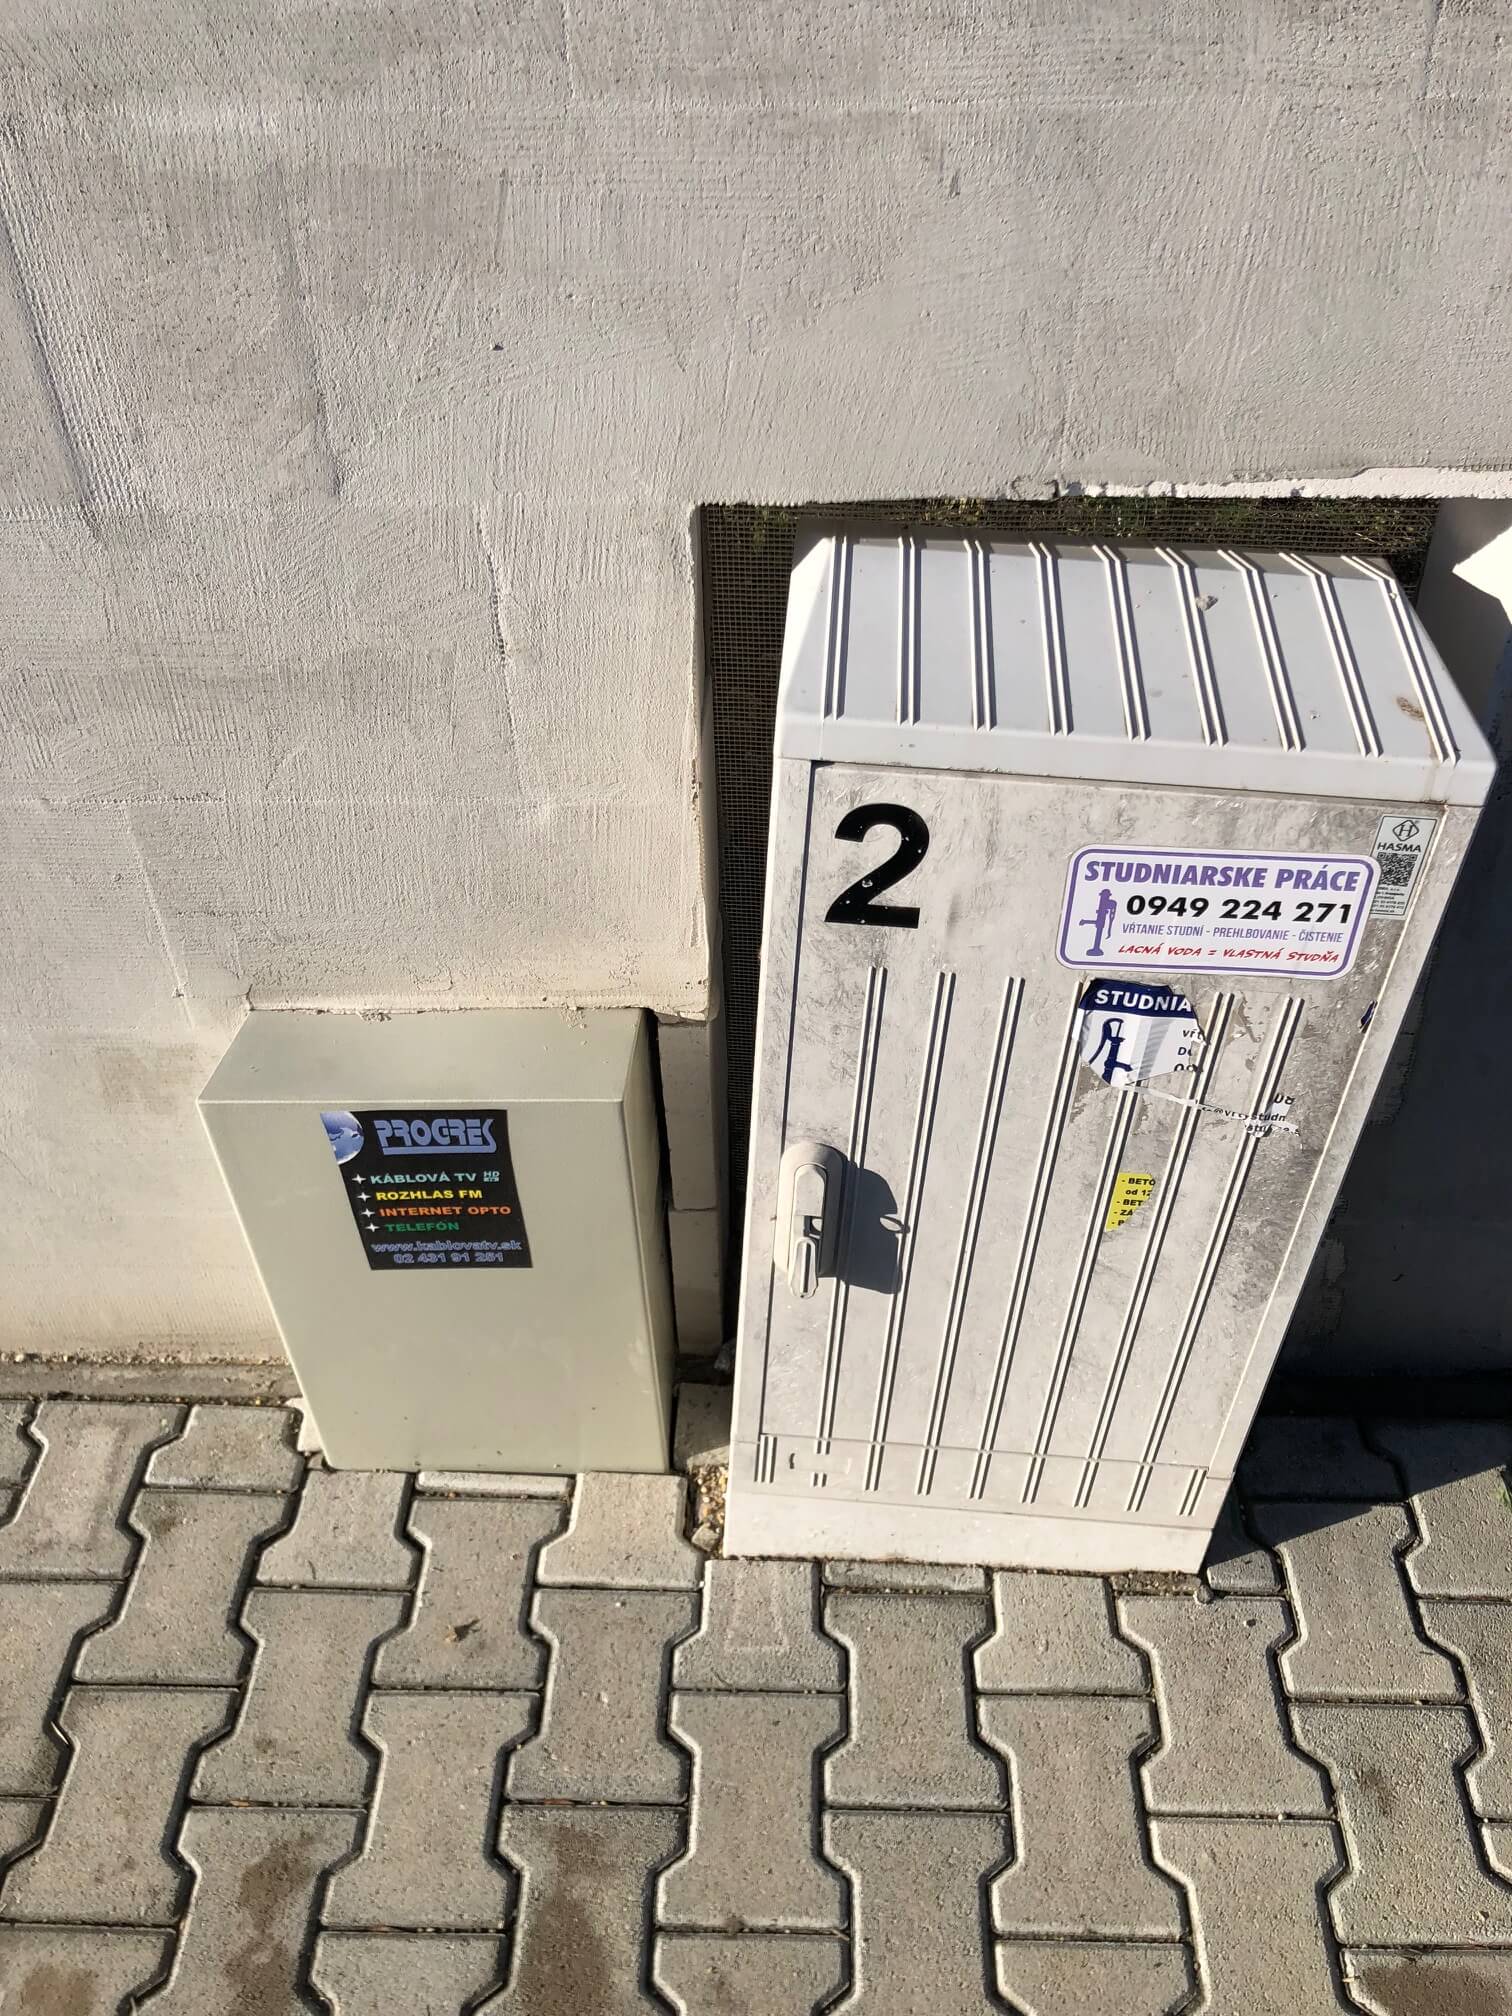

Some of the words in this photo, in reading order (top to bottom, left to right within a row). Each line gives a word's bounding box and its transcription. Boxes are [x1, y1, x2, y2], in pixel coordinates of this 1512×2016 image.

[1377, 843, 1421, 852] HASMA
[824, 803, 930, 929] 2
[1084, 860, 1268, 888] STUDNIARSKE
[1274, 864, 1360, 892] PRÁCE
[1126, 895, 1210, 918] 0949
[1219, 898, 1282, 921] 224
[1292, 902, 1352, 924] 271
[1166, 925, 1204, 936] STUDNÍ
[1213, 927, 1289, 941] PREHLBOVANIE
[1298, 929, 1344, 943] ČISTENIE
[1118, 943, 1165, 955] LACNÁ
[1167, 947, 1202, 956] VODA
[1223, 947, 1285, 959] VLASTNÁ
[1286, 951, 1340, 963] STUDŇA
[373, 1118, 497, 1155] PROGRES
[370, 1171, 450, 1184] KÁBLOVÁ
[454, 1172, 477, 1182] TV
[375, 1190, 454, 1200] ROZHLAS
[458, 1190, 483, 1199] FM
[379, 1207, 463, 1217] INTERNET
[467, 1206, 512, 1215] OPTO
[384, 1221, 460, 1232] TELEFÓN
